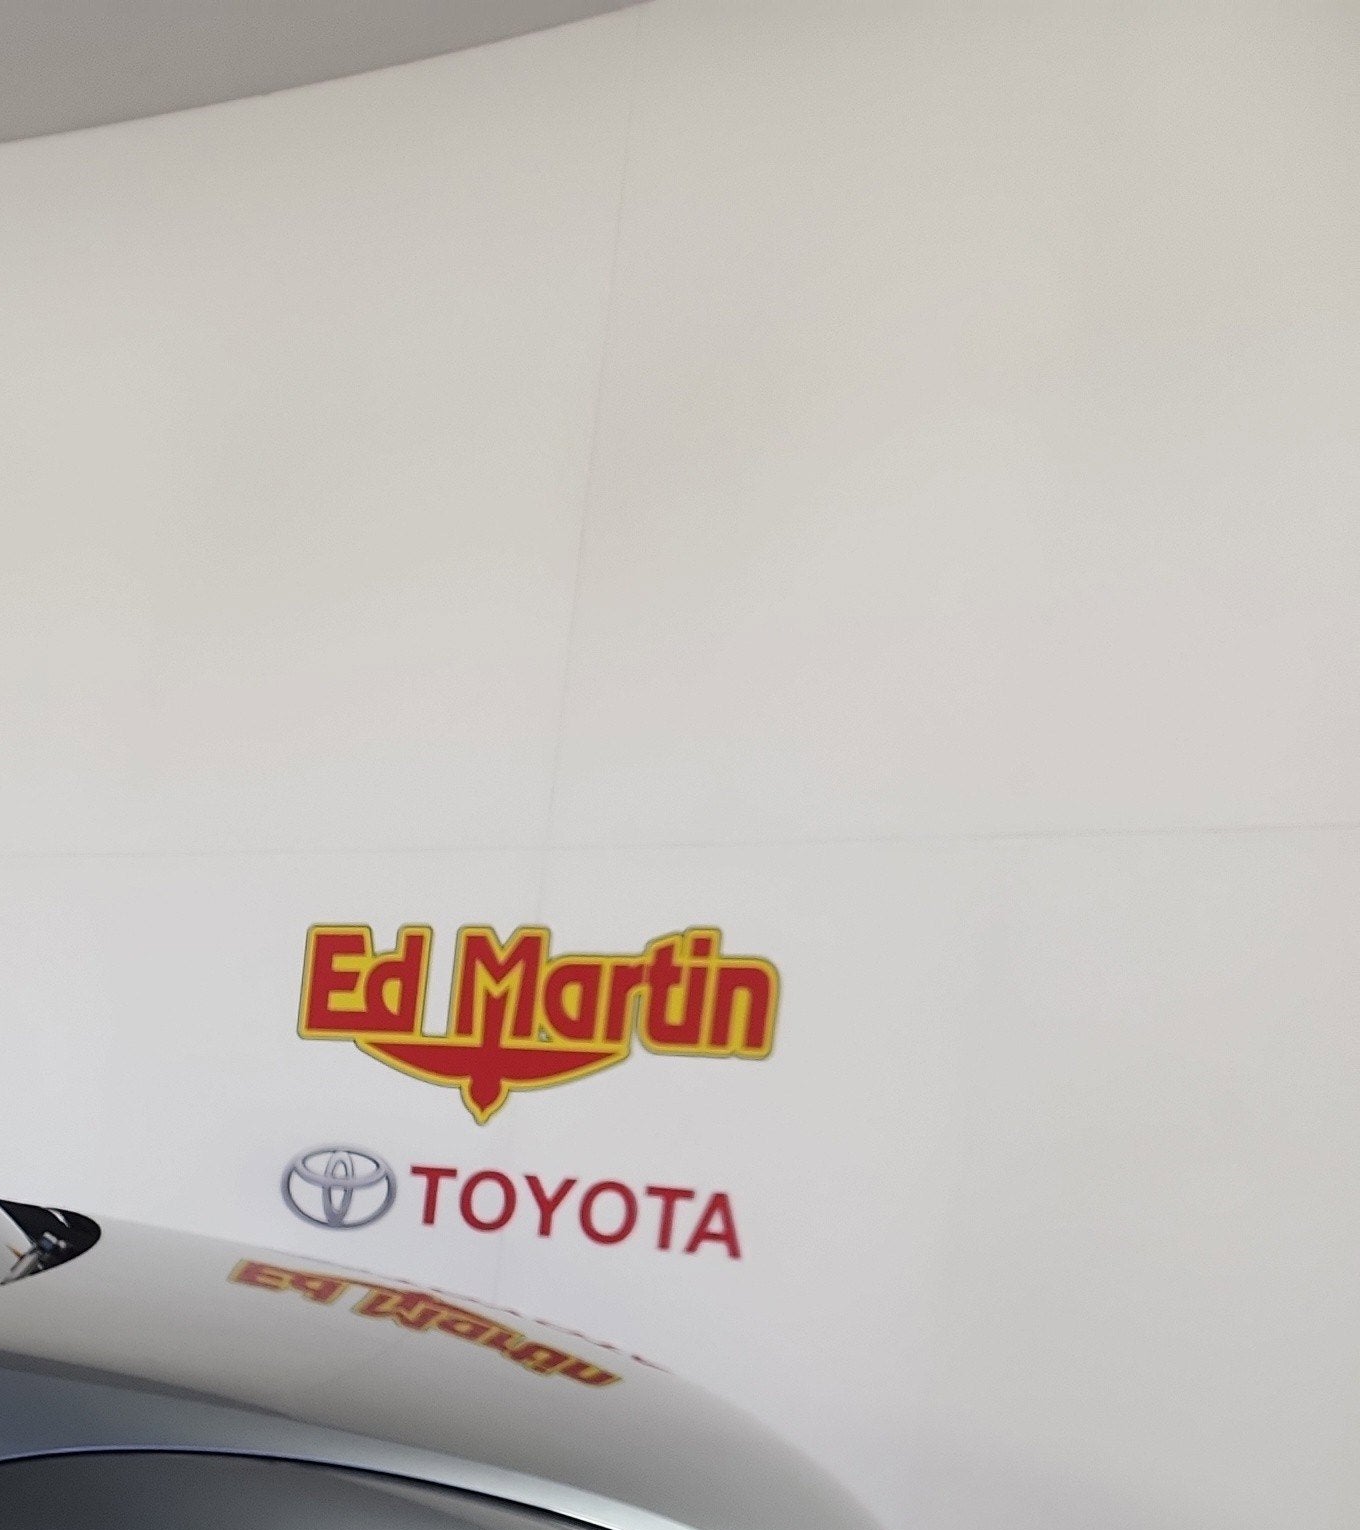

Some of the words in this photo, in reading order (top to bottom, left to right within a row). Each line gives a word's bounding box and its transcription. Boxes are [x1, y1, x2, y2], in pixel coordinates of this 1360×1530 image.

[302, 930, 428, 1037] Ed
[452, 928, 776, 1055] Martin
[410, 1164, 743, 1259] TOYOTA
